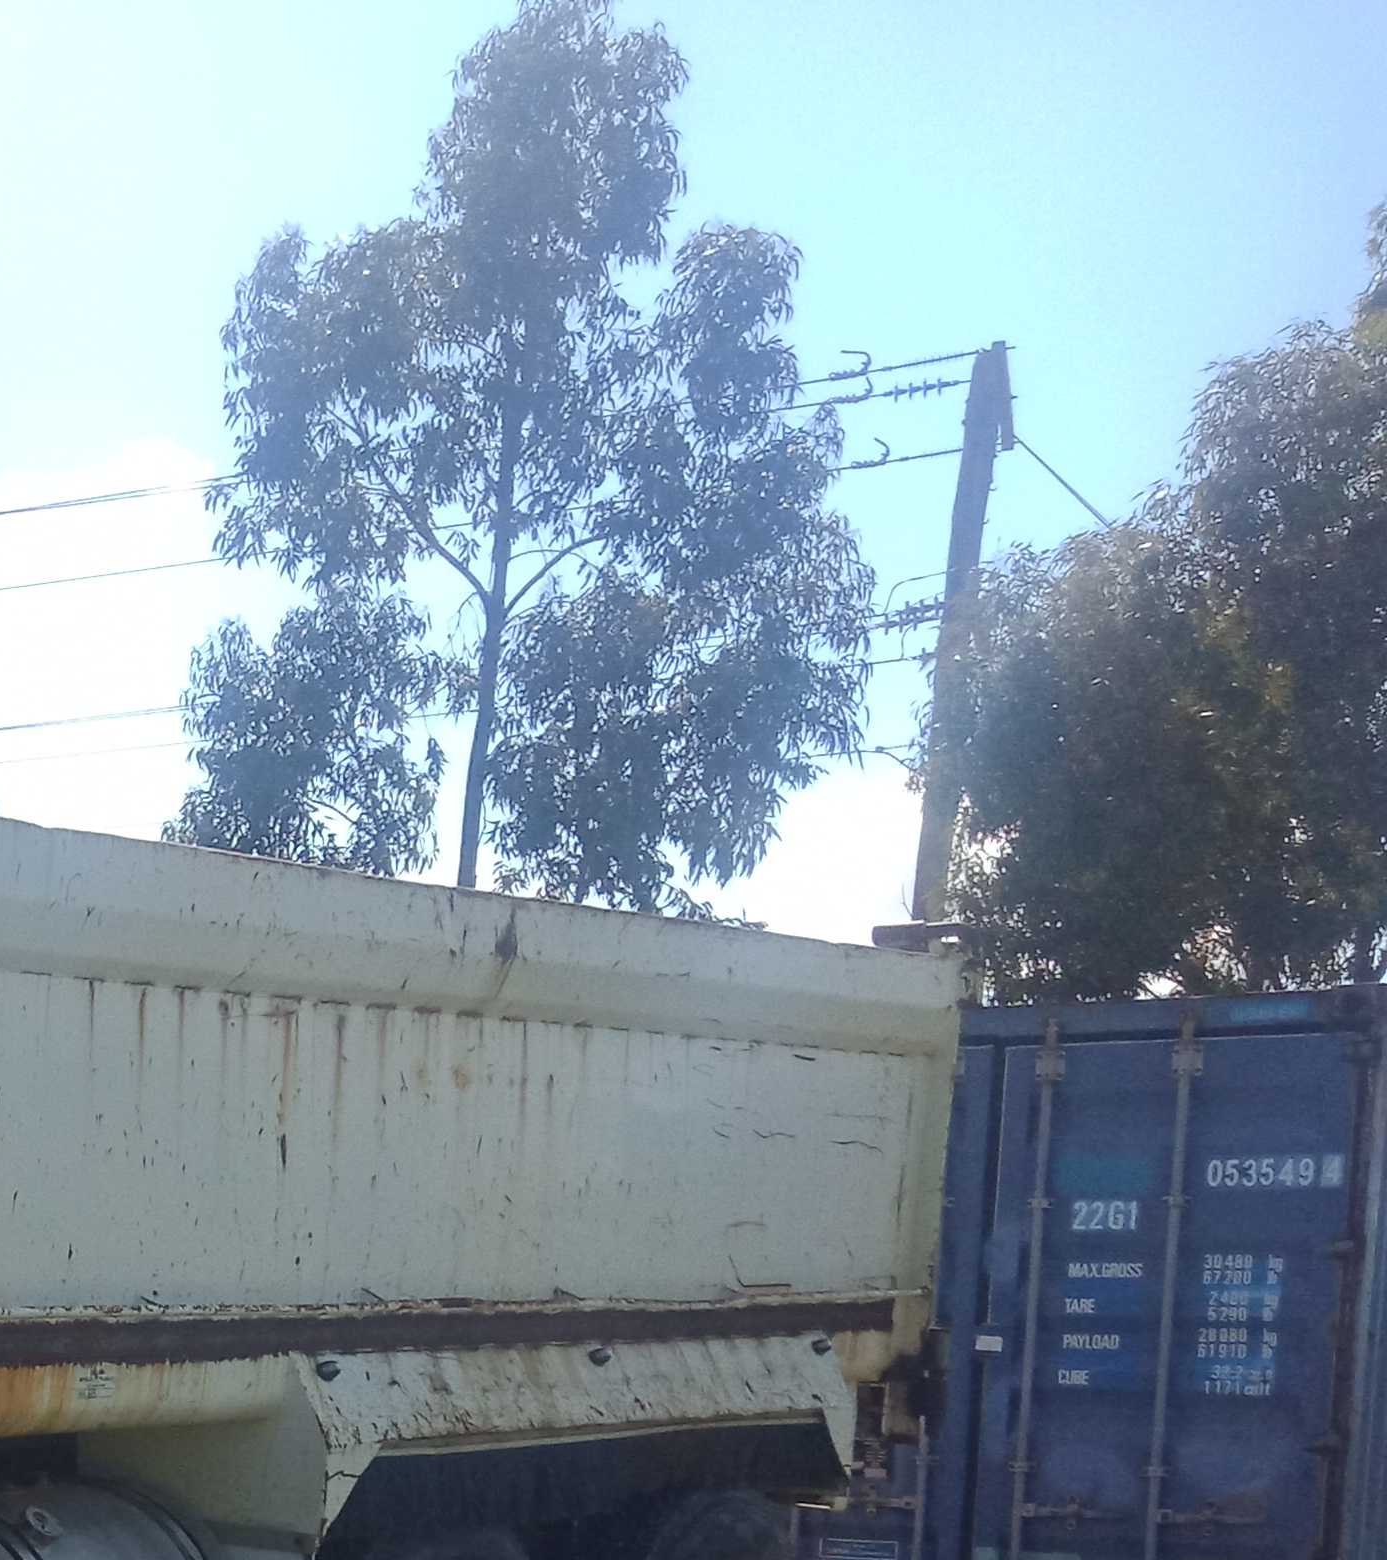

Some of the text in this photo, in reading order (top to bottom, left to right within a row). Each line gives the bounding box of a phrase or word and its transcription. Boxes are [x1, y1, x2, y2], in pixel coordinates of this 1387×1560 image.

[1072, 1201, 1138, 1231] 22G1
[1065, 1298, 1096, 1313] TARE
[1063, 1334, 1120, 1349] PAYLOAD
[1058, 1369, 1089, 1384] CUBE
